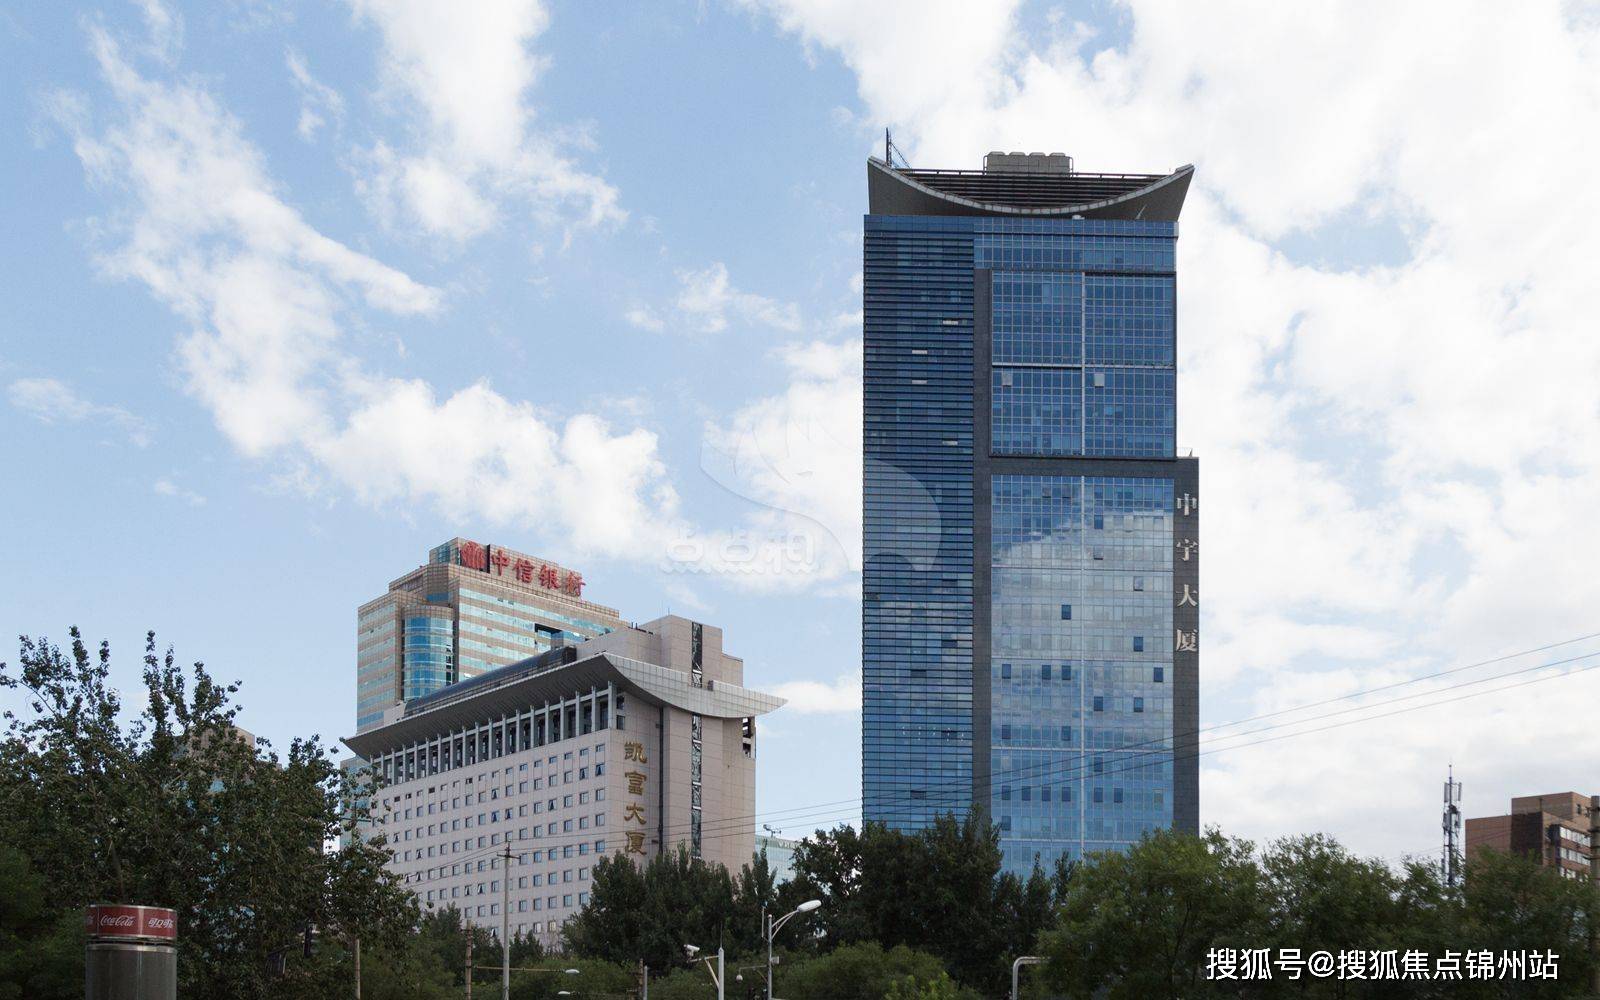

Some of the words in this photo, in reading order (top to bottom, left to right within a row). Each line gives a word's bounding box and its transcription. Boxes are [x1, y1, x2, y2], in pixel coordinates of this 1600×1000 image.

[491, 549, 586, 597] 中信银行
[624, 741, 648, 856] 凯富大厦
